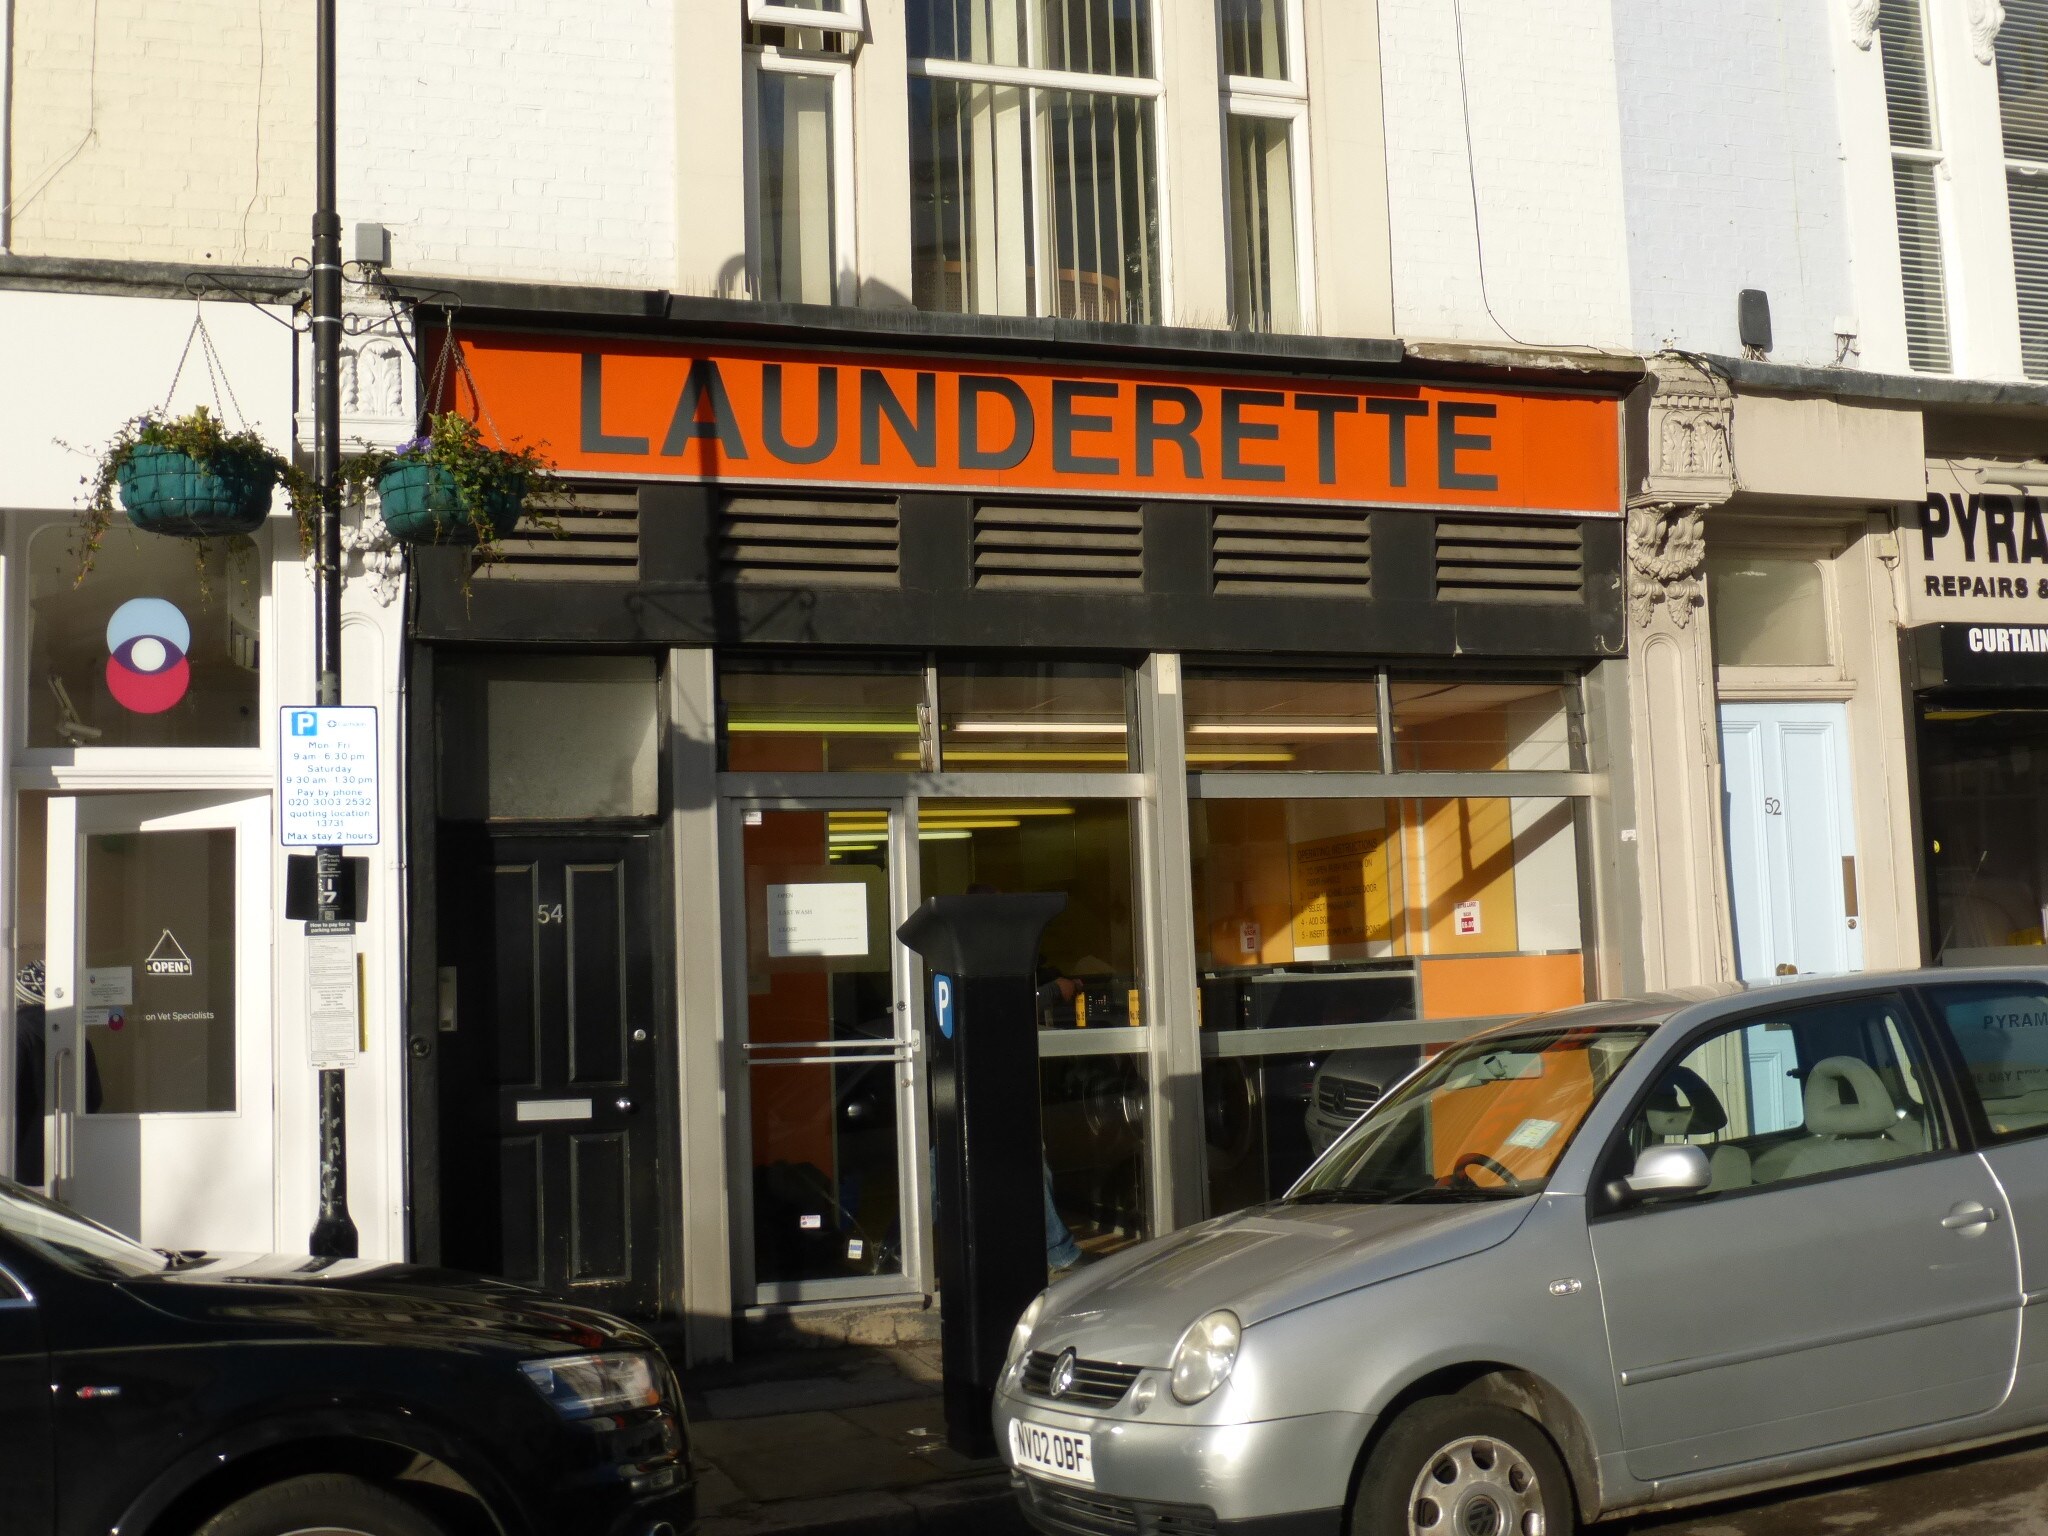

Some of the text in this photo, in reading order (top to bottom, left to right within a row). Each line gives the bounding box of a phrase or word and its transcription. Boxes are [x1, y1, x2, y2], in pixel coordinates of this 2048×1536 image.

[581, 352, 1498, 492] LAUNDERETTE
[1925, 575, 2029, 599] REPAIRS
[308, 741, 351, 749] Mon Fri
[307, 765, 352, 773] Saturday
[297, 788, 363, 797] Pay by phone
[288, 798, 309, 806] 020
[313, 798, 341, 806] 3003
[1765, 797, 1782, 815] 52
[289, 809, 370, 818] quoting location
[316, 819, 345, 827] 13731
[287, 832, 308, 840] Max
[311, 833, 333, 841] stay
[346, 832, 373, 840] hours
[537, 903, 563, 924] 54
[152, 961, 184, 972] OPEN
[938, 981, 949, 1026] P
[157, 1012, 171, 1020] Vet
[172, 1011, 215, 1022] Specialists
